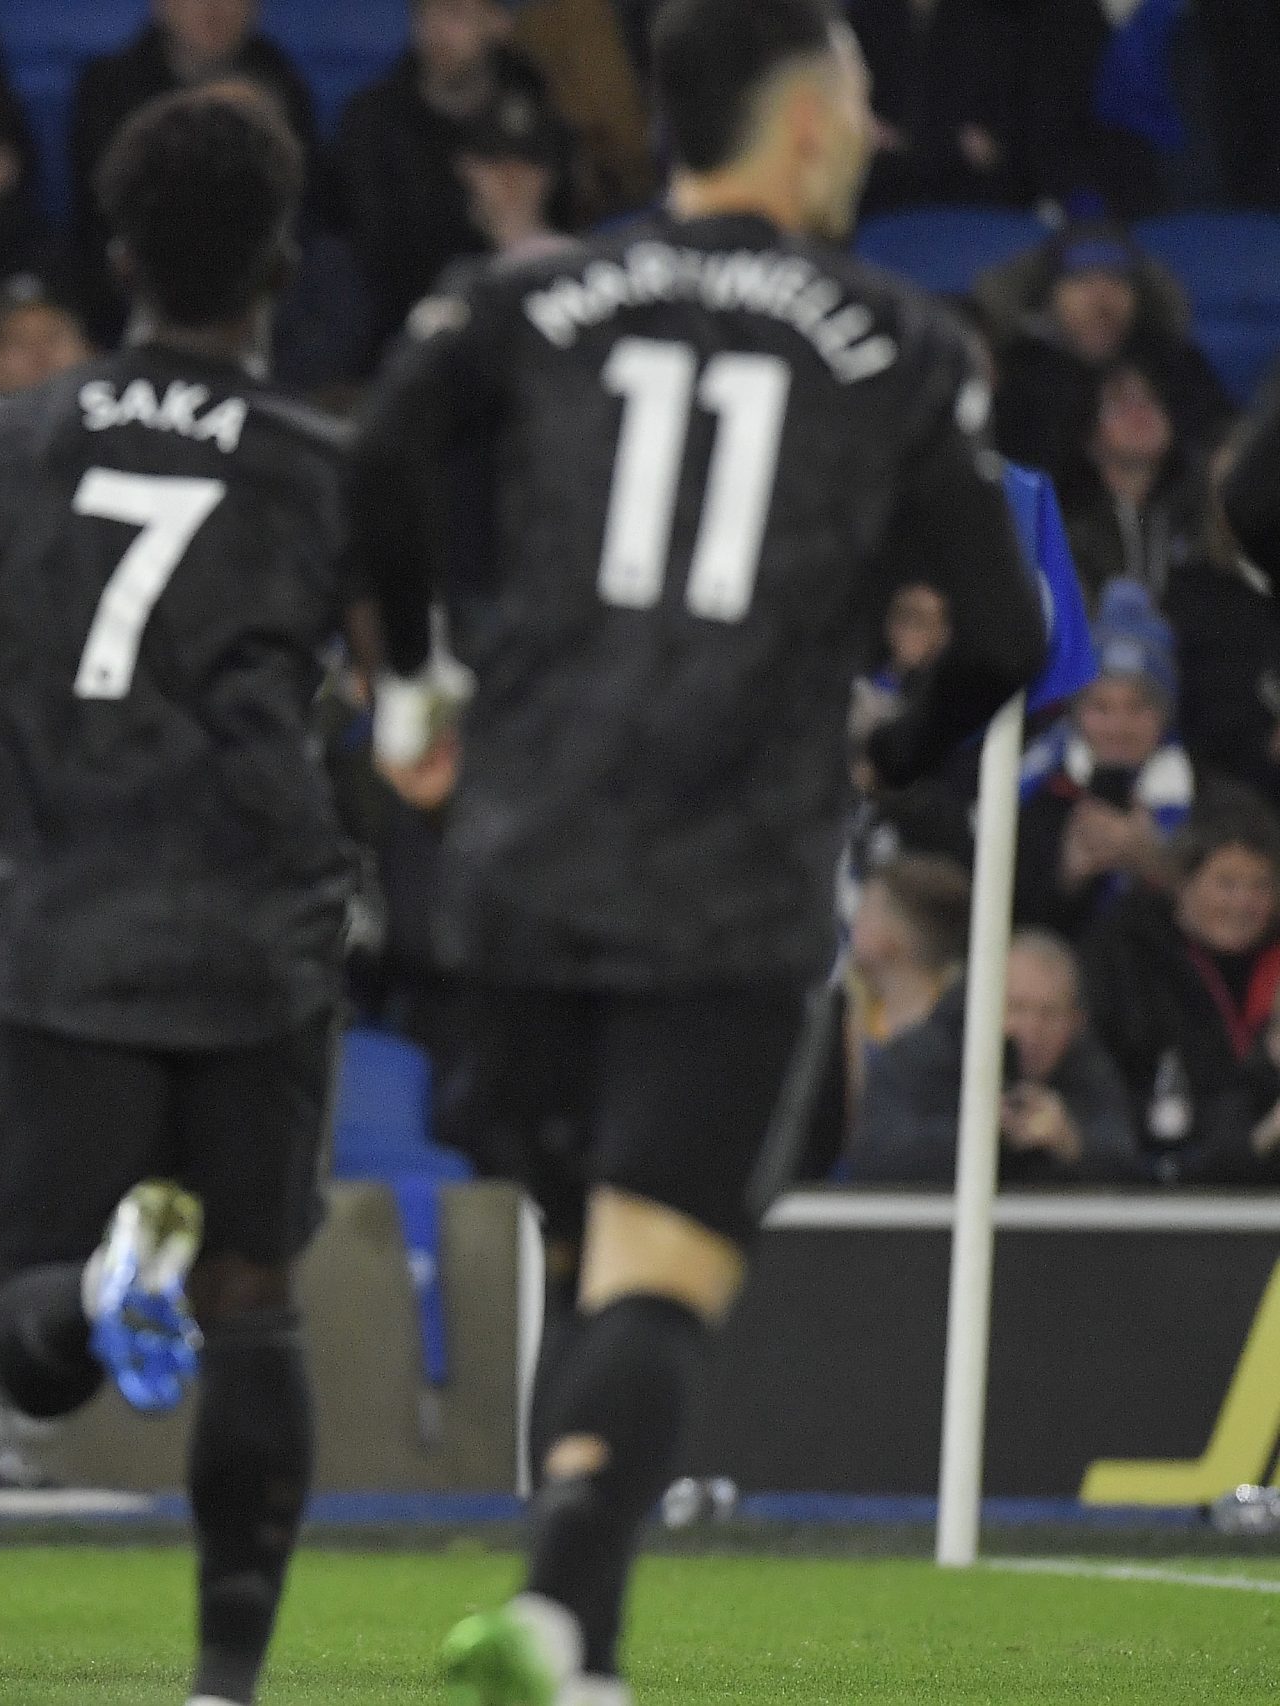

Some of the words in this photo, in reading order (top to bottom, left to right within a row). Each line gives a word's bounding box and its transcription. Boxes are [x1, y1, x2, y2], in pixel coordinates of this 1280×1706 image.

[78, 378, 248, 454] SAKA
[596, 334, 793, 624] 11
[72, 465, 227, 700] 7
